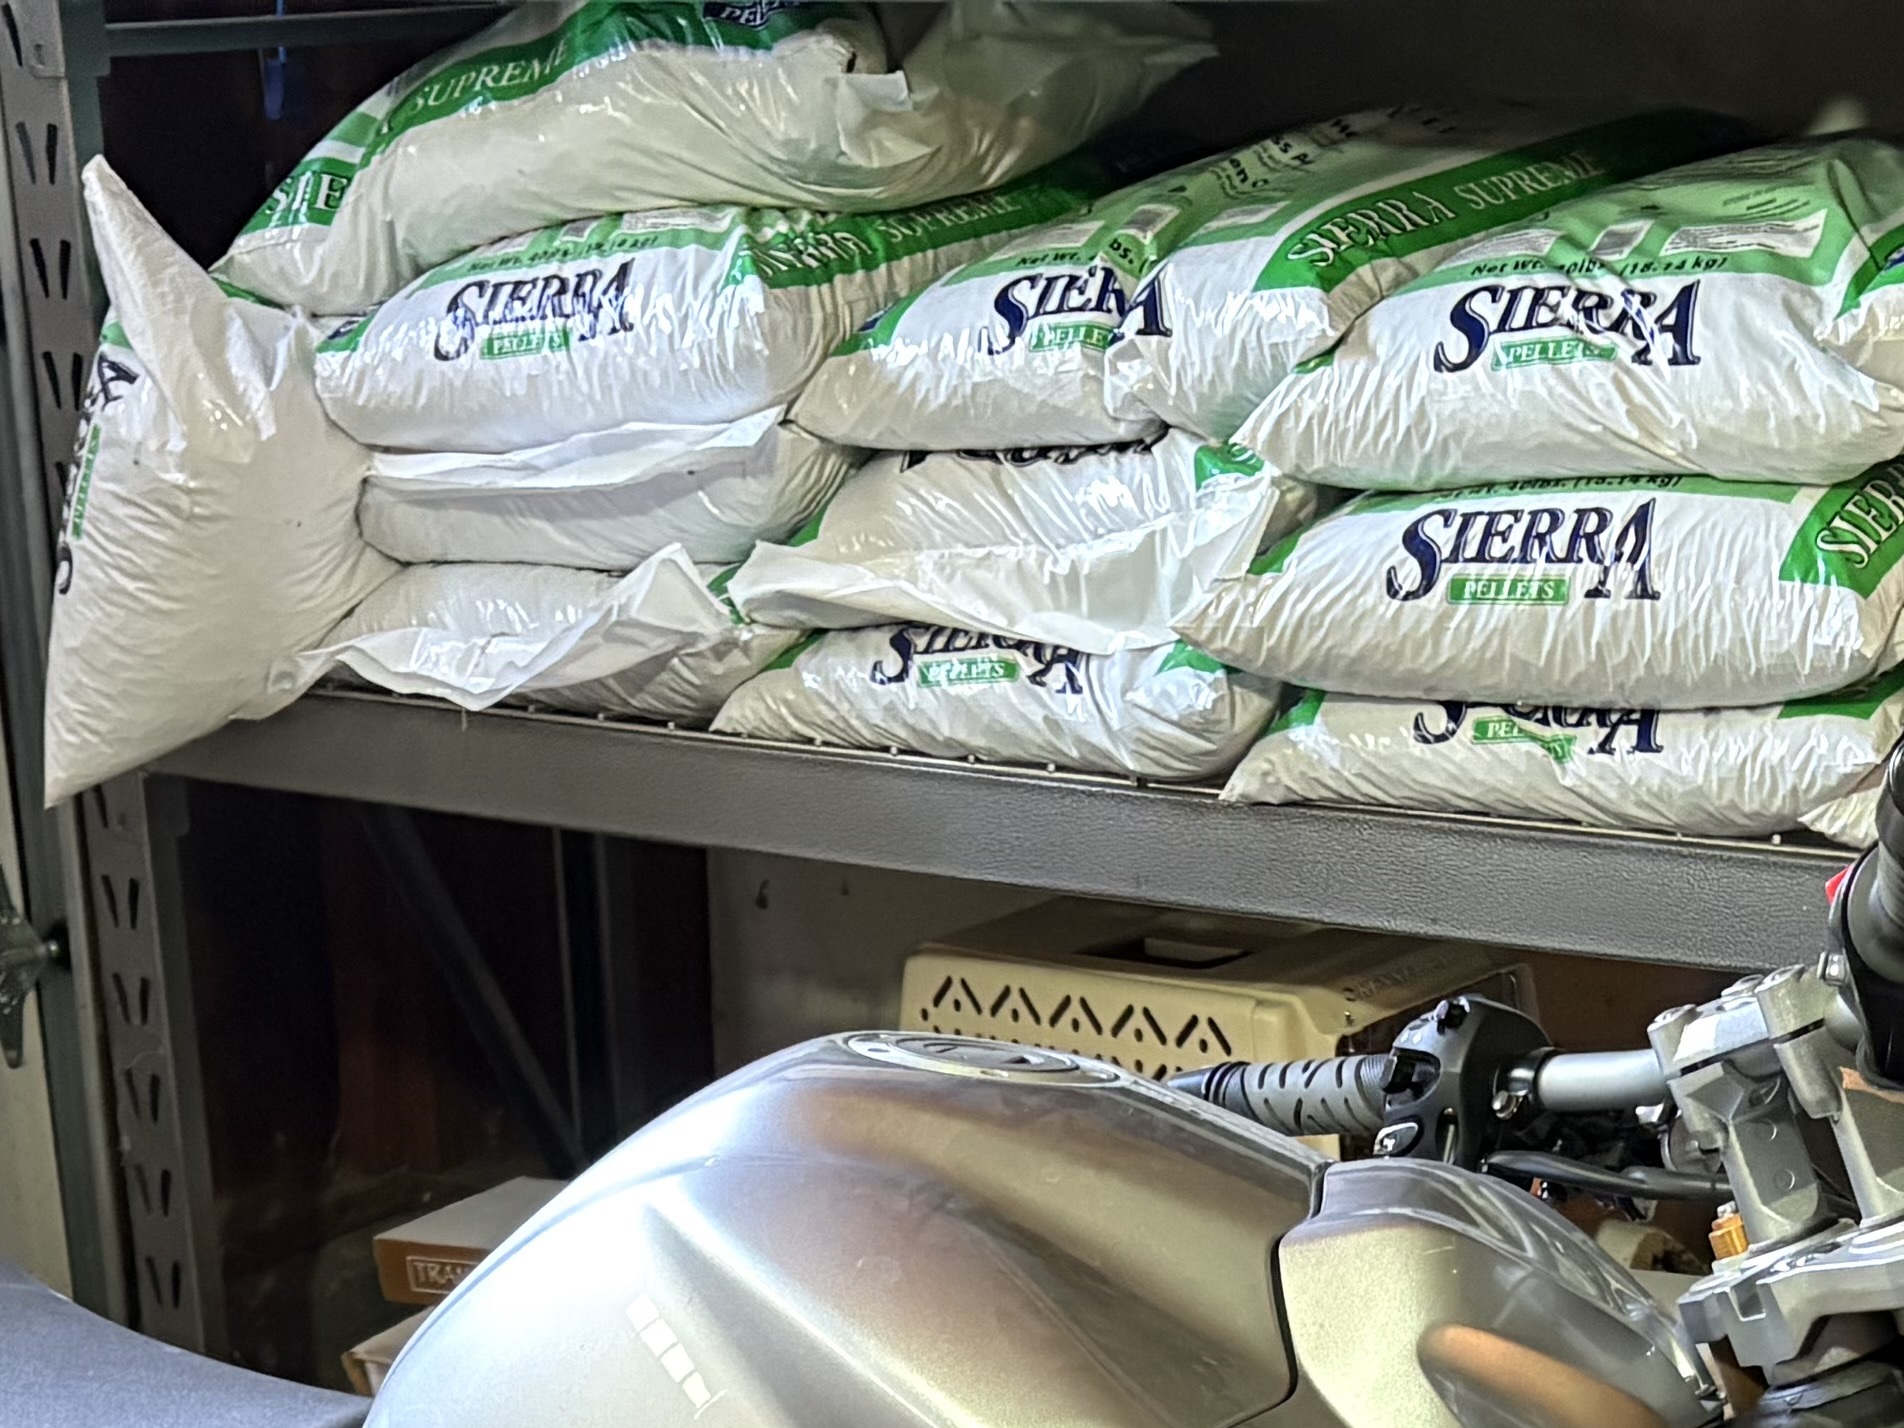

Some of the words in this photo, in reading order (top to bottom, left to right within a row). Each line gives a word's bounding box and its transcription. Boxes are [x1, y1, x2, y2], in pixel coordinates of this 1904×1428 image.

[1287, 190, 1457, 268] SIERRA
[1454, 149, 1605, 211] SUPREME
[433, 258, 636, 362] SIERRA
[1434, 278, 1701, 373] SIERRA
[1386, 497, 1661, 601] SIERRA
[1463, 579, 1556, 600] PELLETS
